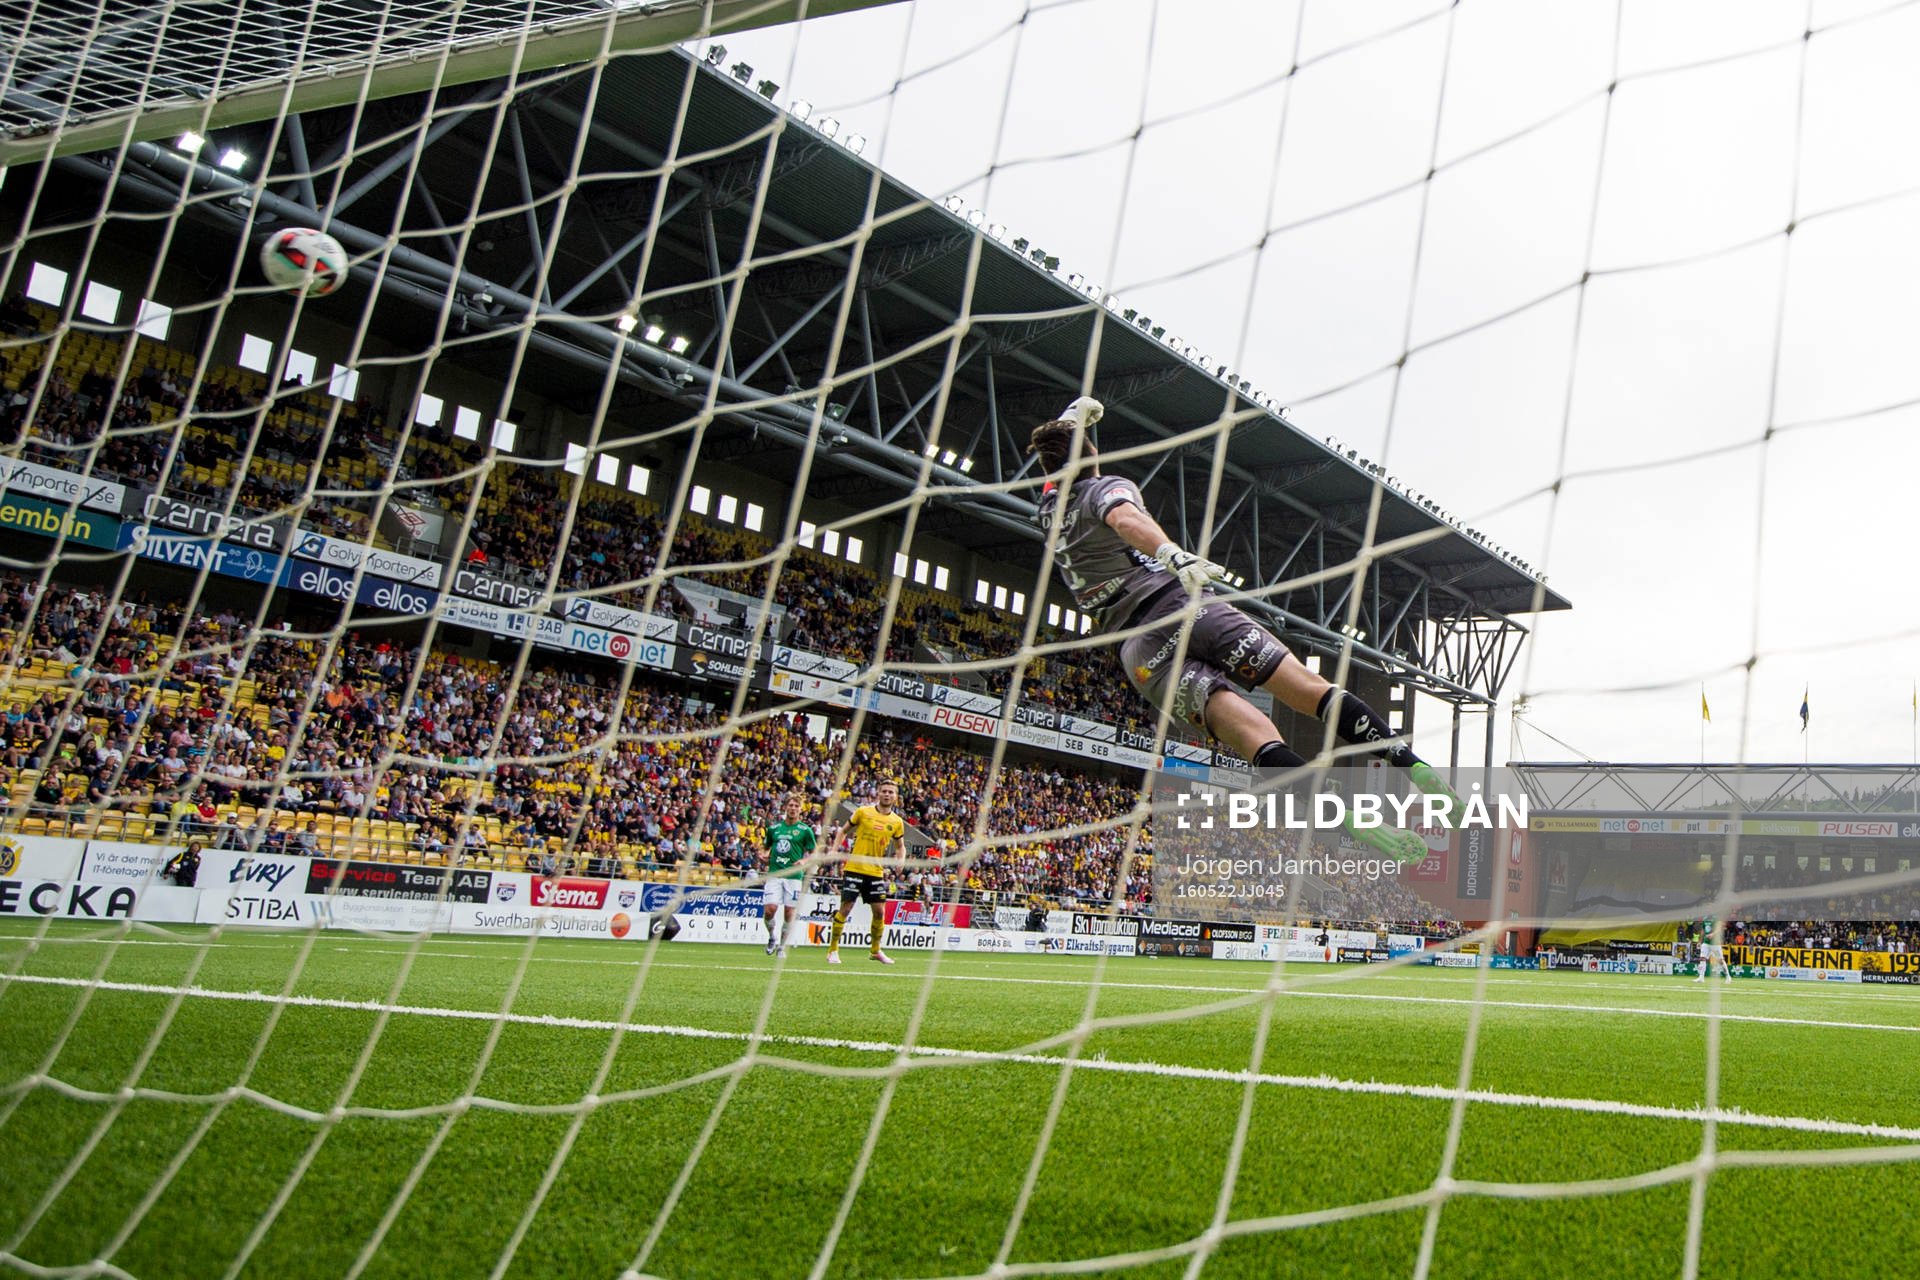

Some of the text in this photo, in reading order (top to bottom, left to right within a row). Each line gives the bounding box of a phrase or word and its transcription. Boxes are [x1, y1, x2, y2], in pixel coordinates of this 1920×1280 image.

[143, 494, 274, 548] Cernera
[127, 525, 227, 573] SILVENT
[300, 566, 355, 601] ellos
[455, 570, 552, 613] Cerner
[374, 584, 428, 615] ellos
[687, 626, 762, 660] Cernera
[870, 671, 925, 698] ernera
[933, 707, 996, 735] PULSEN
[1010, 725, 1057, 747] Riksbyggen
[1065, 738, 1109, 757] SEB SEB
[1823, 822, 1893, 836] PULSEN
[96, 853, 105, 861] Vi
[121, 854, 139, 864] det
[1466, 829, 1480, 896] DIDRIKSONS
[311, 863, 489, 889] Service Team AB
[225, 896, 301, 921] STIBA
[475, 911, 608, 934] Swedbank Sjuhärad
[1142, 920, 1201, 937] Mediacad
[885, 927, 936, 947] Måleri
[1600, 960, 1666, 974] TIPS ELIT
